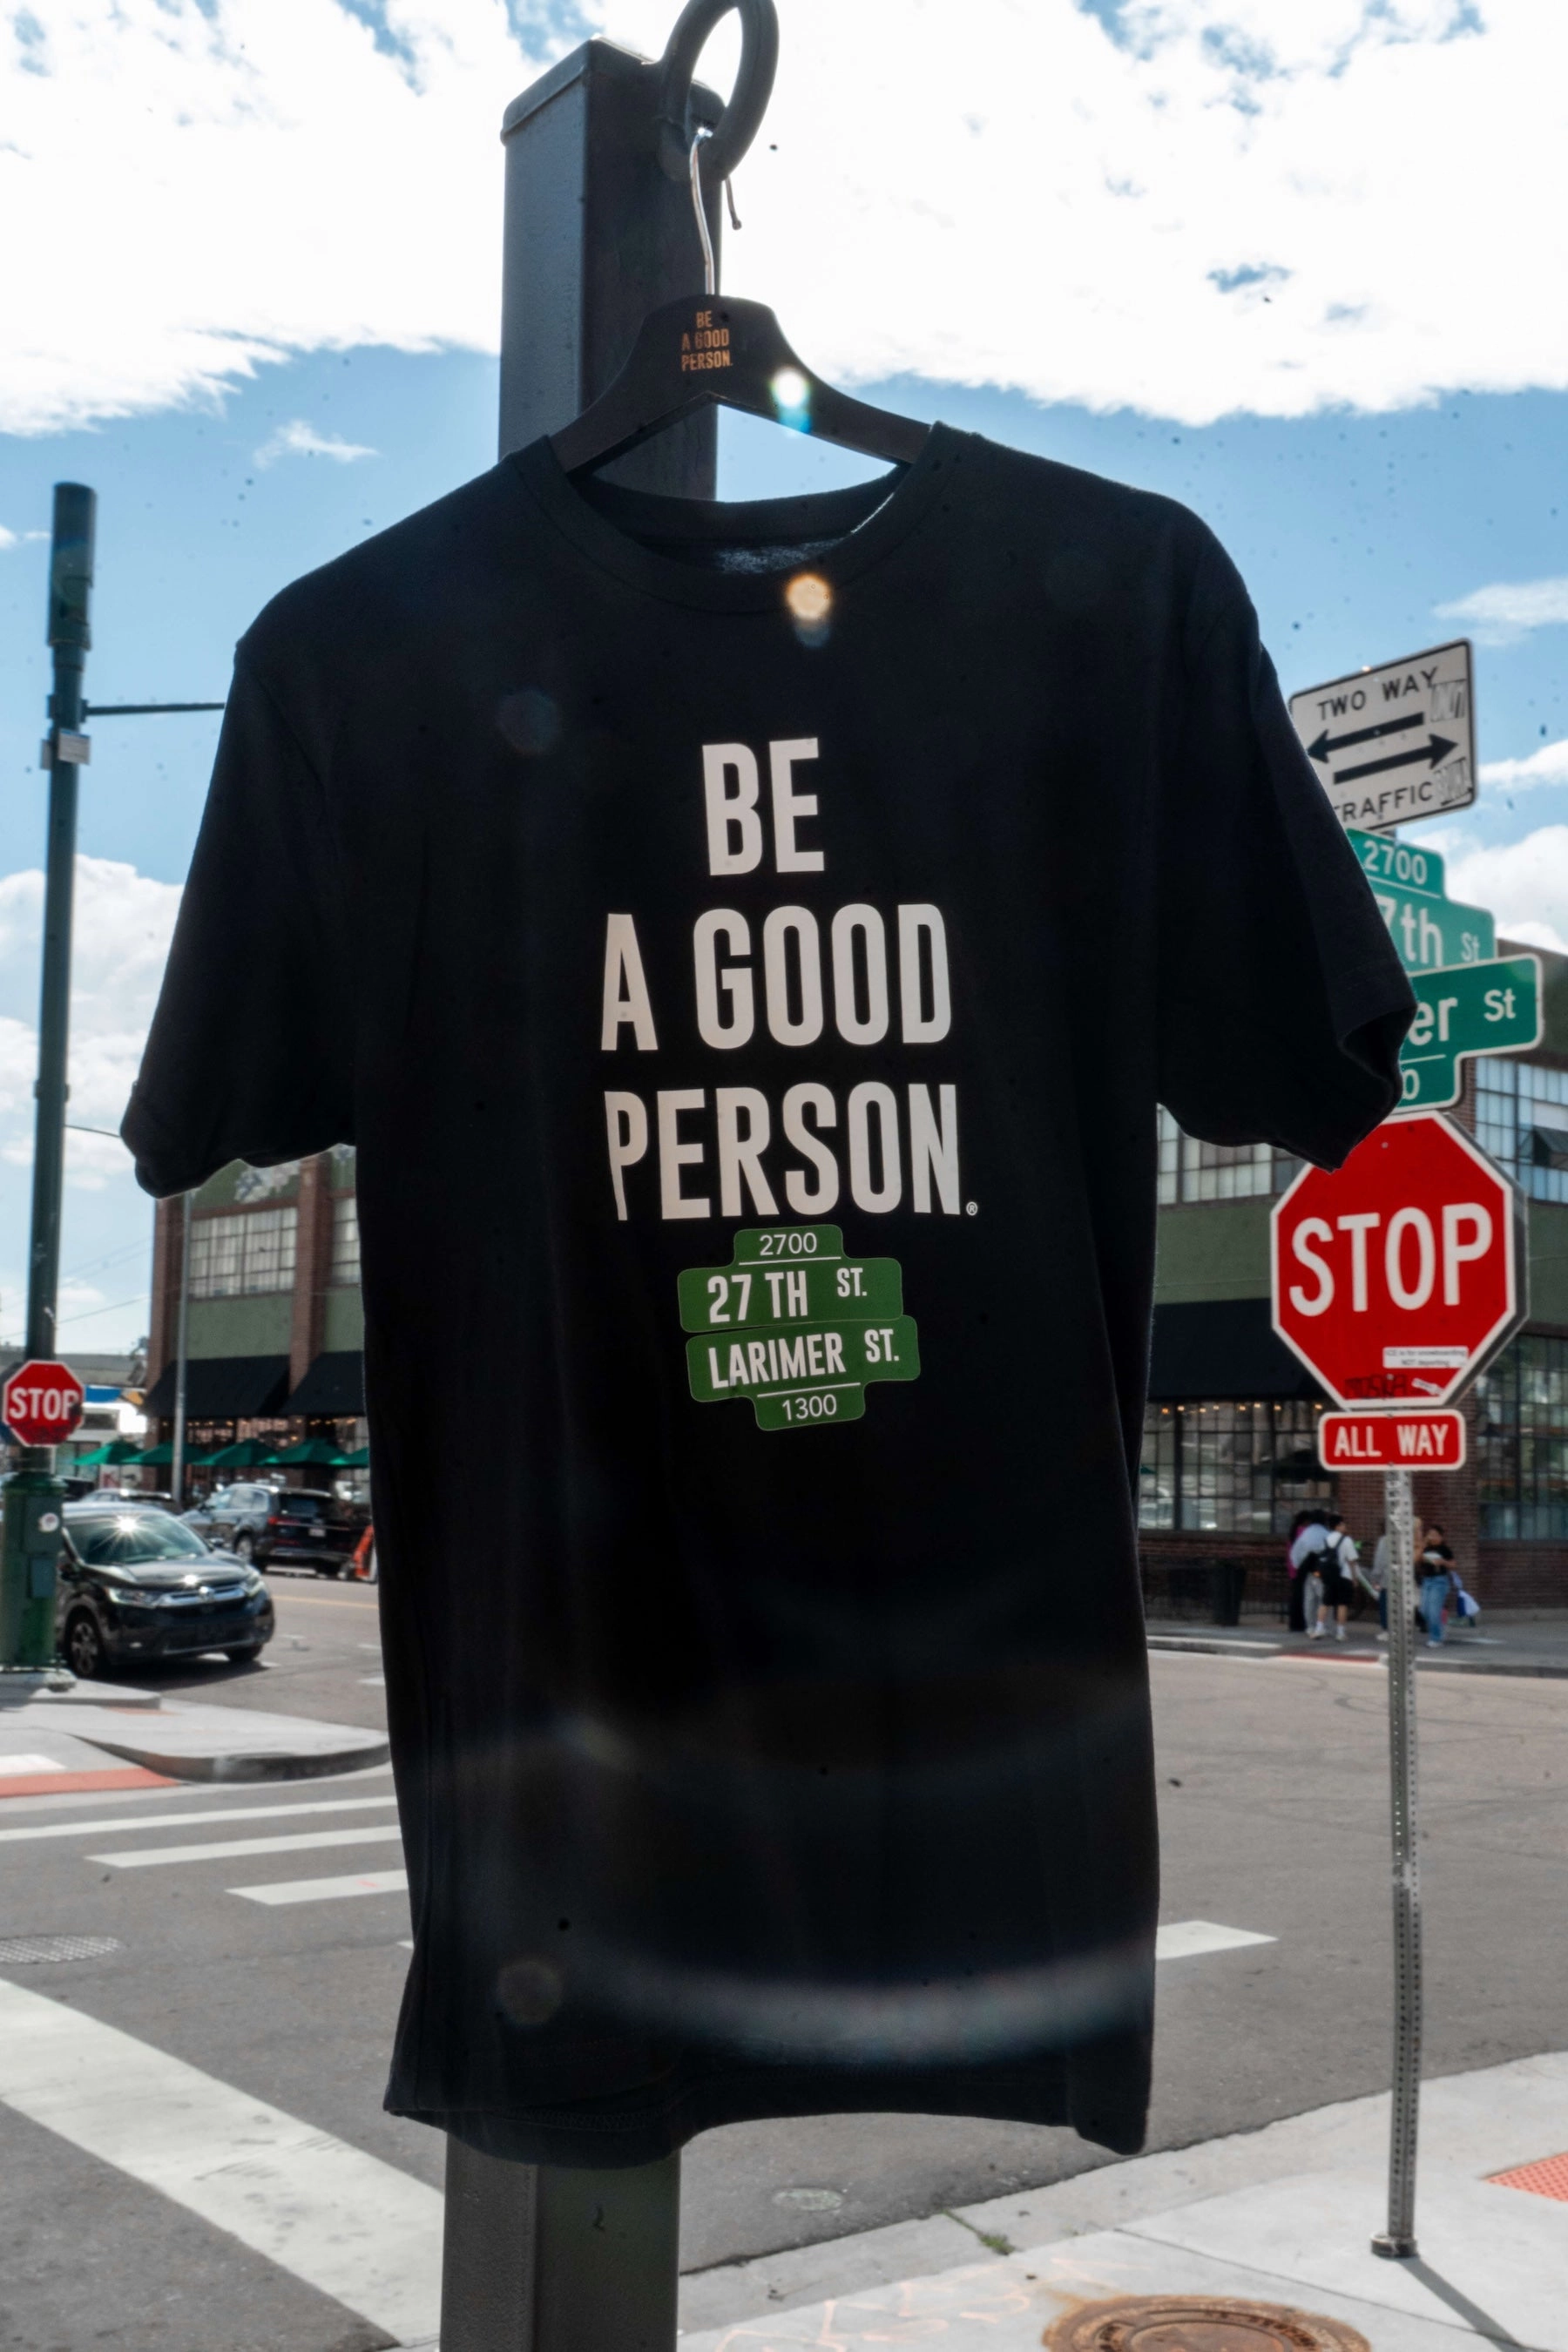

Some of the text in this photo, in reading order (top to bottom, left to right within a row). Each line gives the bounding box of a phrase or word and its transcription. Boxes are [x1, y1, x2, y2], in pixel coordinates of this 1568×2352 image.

[681, 328, 729, 351] A GOOD
[697, 310, 713, 328] BE
[1317, 666, 1438, 720] TWO WAY
[702, 737, 824, 875] BE
[1363, 840, 1427, 885] 2700
[1375, 894, 1480, 967] 7th St
[601, 903, 951, 1051] A GOOD
[1484, 988, 1517, 1022] St
[759, 1232, 817, 1256] 2700
[1288, 1202, 1493, 1317] STOP
[707, 1267, 868, 1323] 27 TH ST.
[708, 1328, 900, 1389] LARIMER ST.
[9, 1388, 79, 1422] STOP
[782, 1394, 837, 1421] 1300
[1334, 1423, 1449, 1457] ALL WAY
